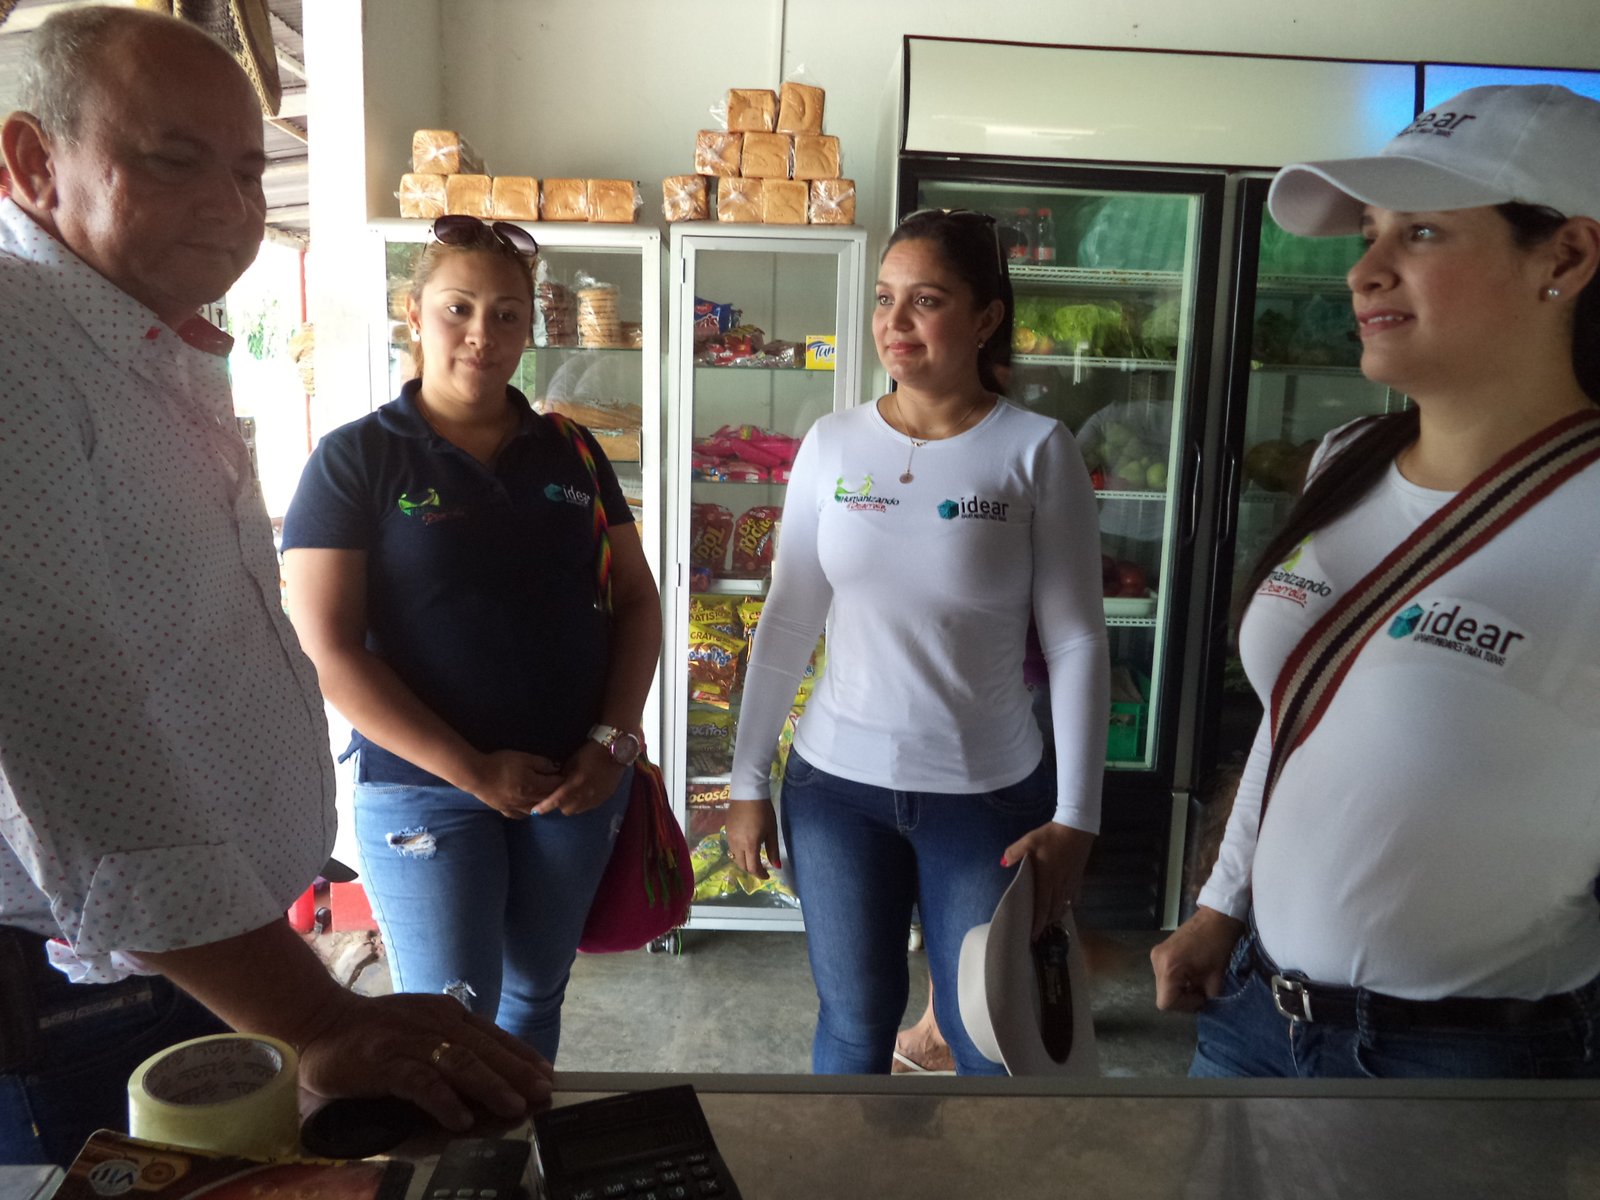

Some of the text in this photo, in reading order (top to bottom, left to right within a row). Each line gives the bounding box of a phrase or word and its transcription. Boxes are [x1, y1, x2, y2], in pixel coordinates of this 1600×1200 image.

[1415, 112, 1477, 130] ear
[960, 495, 1010, 517] idear
[1419, 601, 1526, 655] idear
[688, 787, 731, 804] ocose
